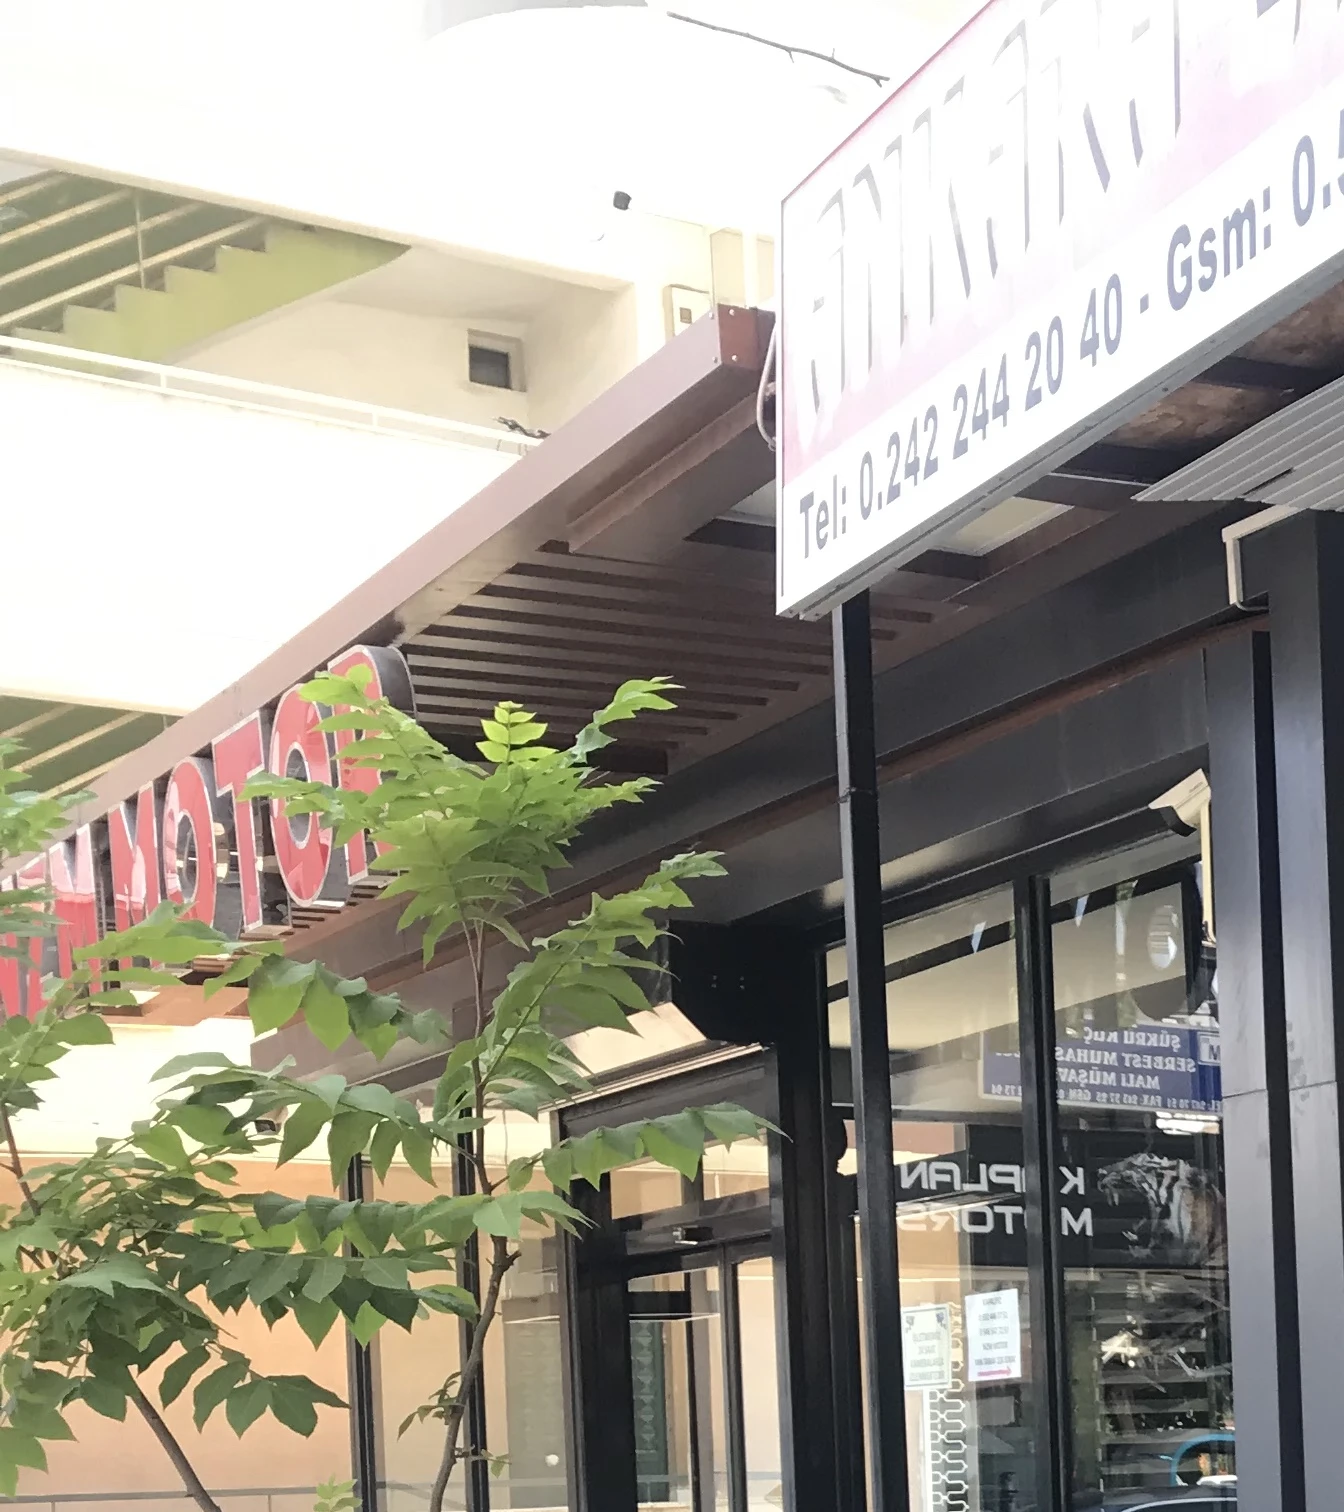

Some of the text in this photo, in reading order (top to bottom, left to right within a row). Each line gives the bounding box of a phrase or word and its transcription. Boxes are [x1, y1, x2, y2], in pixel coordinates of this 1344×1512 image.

[799, 474, 848, 559] Tel:
[859, 404, 939, 521] 0.242
[952, 352, 1008, 461] 244
[1024, 315, 1065, 412] 20
[1080, 272, 1123, 368] 40
[1166, 187, 1272, 312] Gsm:
